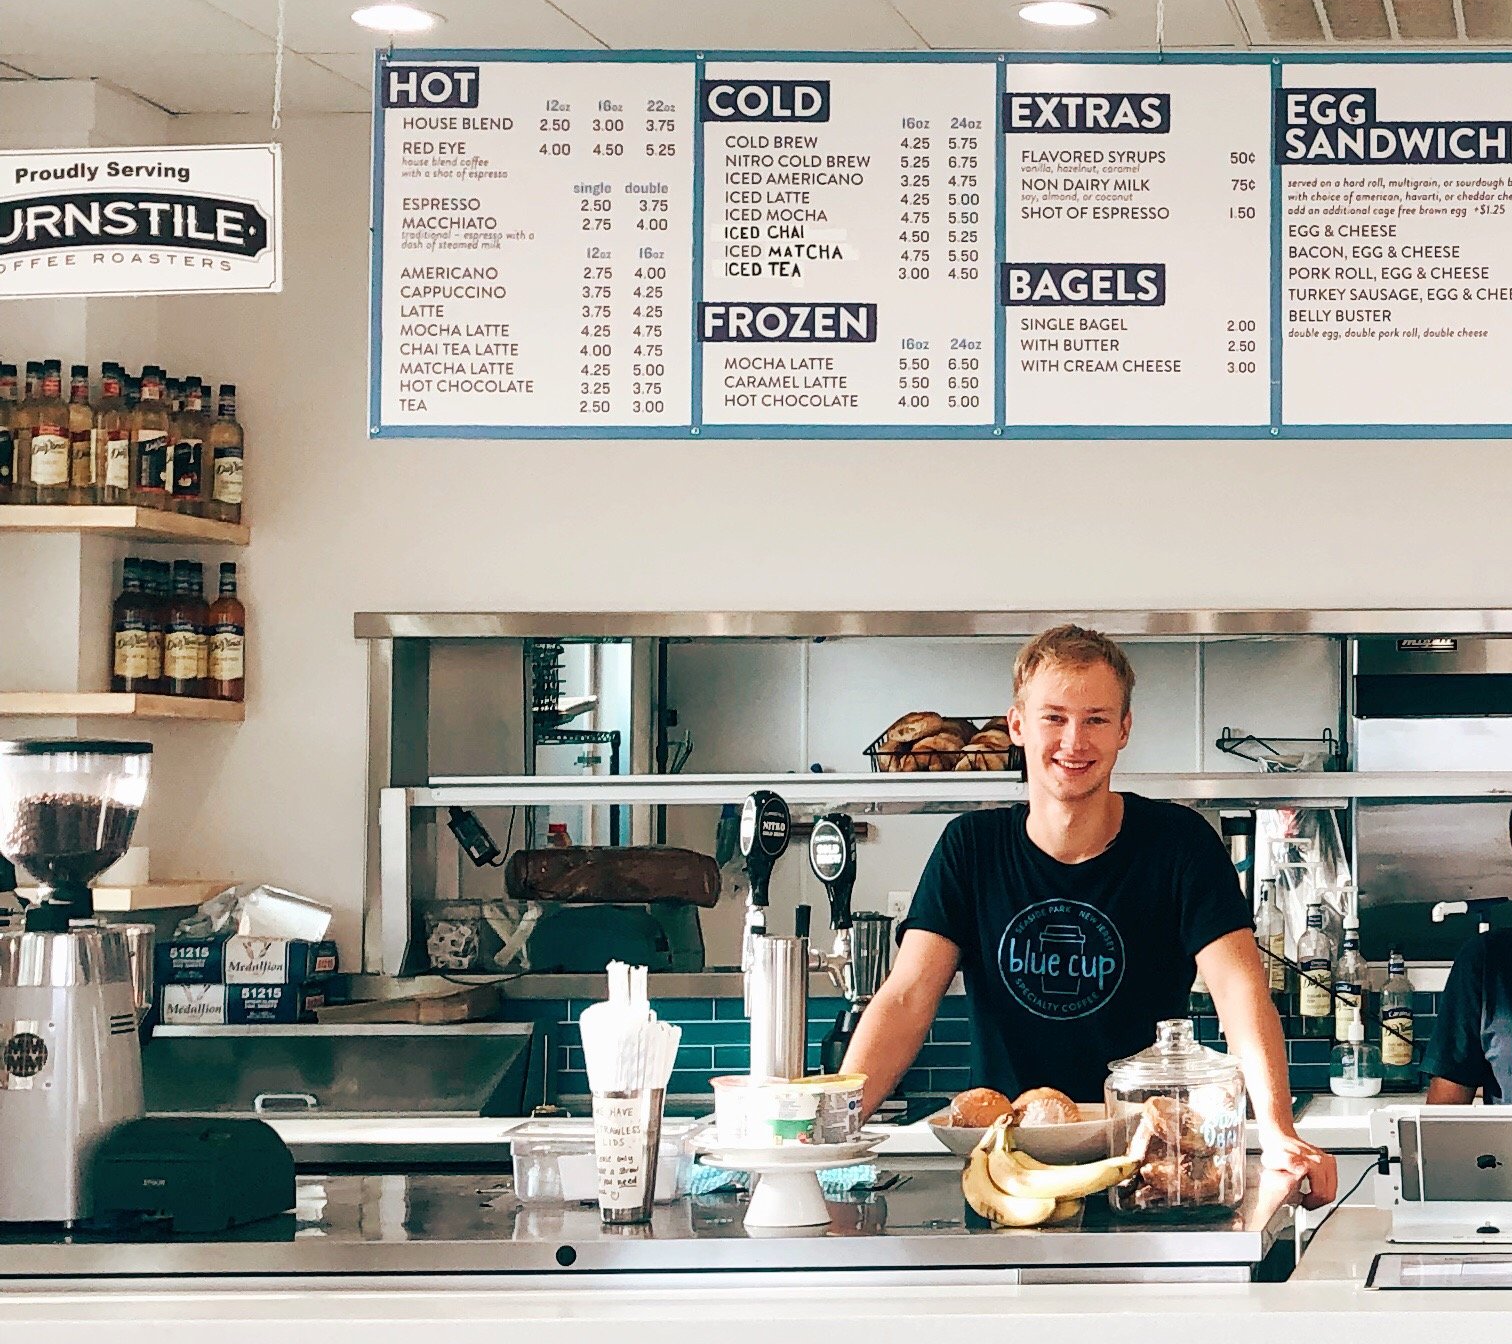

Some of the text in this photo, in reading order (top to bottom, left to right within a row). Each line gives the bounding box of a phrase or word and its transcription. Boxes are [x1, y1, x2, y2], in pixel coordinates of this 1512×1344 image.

[389, 71, 476, 103] HOT
[707, 85, 822, 117] COLD
[1011, 96, 1162, 129] EXTRAS
[1287, 93, 1366, 125] EGG
[403, 117, 675, 132] HOUSE BLEND 2.50 3.00 3.75
[402, 141, 466, 155] RED EYE
[725, 135, 818, 149] COLD BREW
[725, 154, 871, 169] NITRO COLD BREW
[1021, 150, 1256, 165] FLAVORED SYRUPS 50¢
[15, 161, 191, 184] Proudly Serving
[725, 171, 864, 186] ICED AMERICANO
[573, 181, 669, 197] single double
[1021, 178, 1256, 192] NON DAIRY MILK 75¢
[402, 197, 481, 212] ESPRESSO
[725, 190, 810, 205] ICED LATTE
[725, 208, 828, 222] ICED MOCHA
[1021, 206, 1170, 220] SHOT OF ESPRESSO
[402, 216, 498, 230] MACCHIATO
[724, 224, 804, 240] ICED CHAI
[1288, 224, 1397, 238] EGG & CHEESE
[725, 243, 843, 260] ICED MATCHA
[1288, 245, 1460, 260] BACON, EGG & CHEESE
[93, 252, 232, 272] ROASTERS
[725, 261, 801, 278] ICED TEA
[400, 266, 499, 280] AMERICANO
[1288, 266, 1489, 282] PORK ROLL, EGG & CHEESE
[400, 285, 507, 299] CAPPUCCINO
[1009, 269, 1158, 301] BAGELS
[1287, 288, 1347, 302] TURKEY
[1349, 288, 1423, 303] SAUSAGE,
[1427, 287, 1458, 301] EGG
[1462, 287, 1473, 301] &
[400, 304, 444, 318] LATTE
[1289, 309, 1392, 323] BELLY BUSTER
[399, 323, 510, 337] MOCHA LATTE
[704, 306, 868, 339] FROZEN
[1020, 317, 1128, 331] SINGLE BAGEL
[1288, 327, 1489, 341] double egg, double pork roll, double cheese
[399, 342, 519, 357] CHAI TEA LATTE
[1020, 338, 1120, 352] WITH BUTTER
[399, 361, 514, 376] MATCHA LATTE
[724, 356, 834, 371] MOCHA LATTE
[1021, 359, 1182, 373] WITH CREAM CHEESE
[400, 379, 534, 394] HOT CHOCOLATE
[724, 375, 848, 389] CARAMEL LATTE
[398, 398, 428, 412] TEA
[724, 393, 859, 408] HOT CHOCOLATE
[1015, 908, 1047, 935] SEASIDE
[1048, 904, 1072, 914] PARK
[1078, 910, 1097, 924] NEW
[169, 946, 210, 959] 51215
[227, 960, 284, 976] Medallion
[1009, 937, 1116, 991] blue cup
[241, 987, 283, 1000] 51215
[1015, 977, 1101, 1013] SPECIALTY COFFEE
[166, 1002, 223, 1018] Medallion
[609, 1107, 634, 1117] HAVE
[602, 1138, 625, 1147] LIDS
